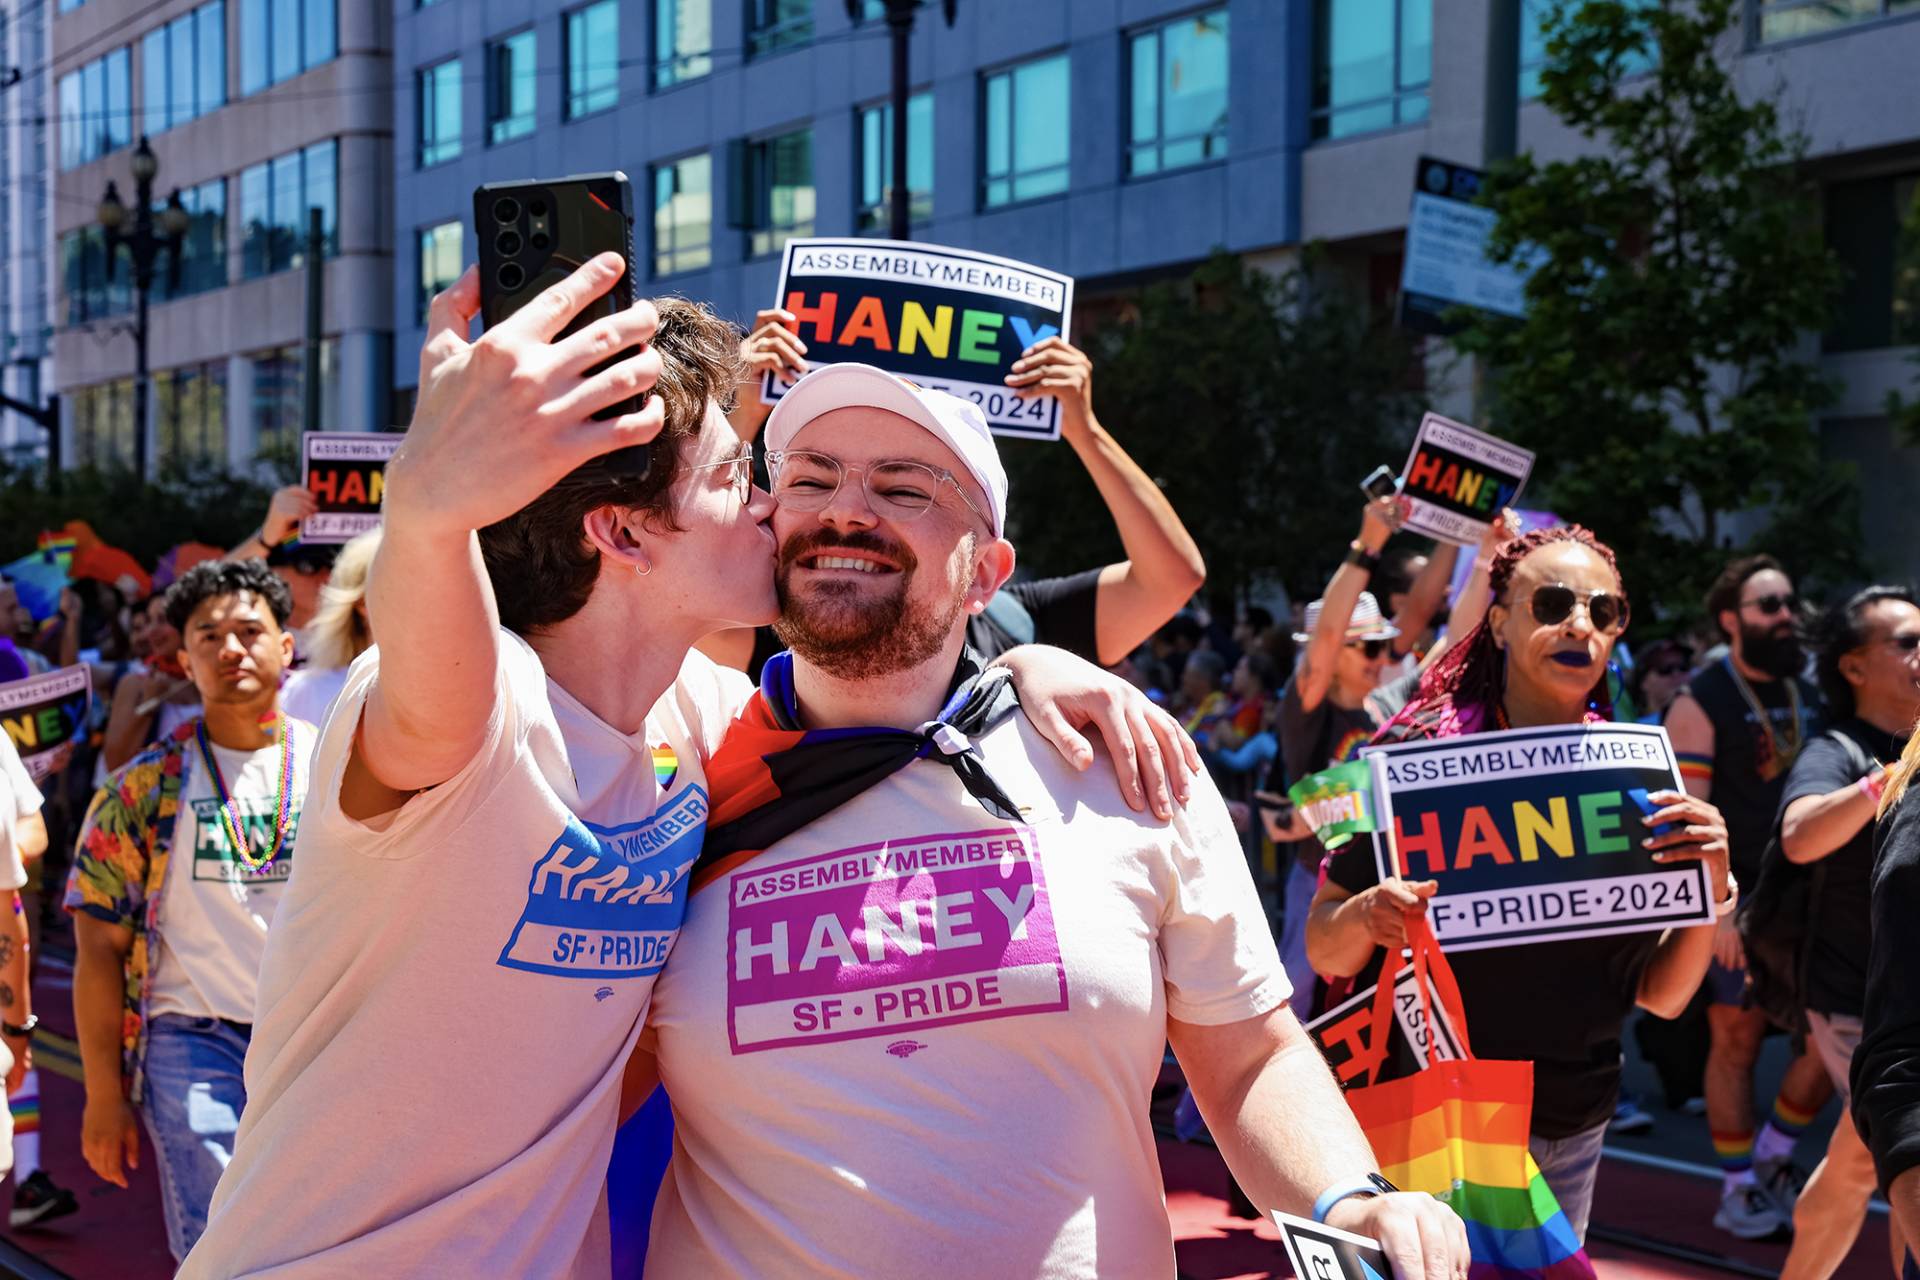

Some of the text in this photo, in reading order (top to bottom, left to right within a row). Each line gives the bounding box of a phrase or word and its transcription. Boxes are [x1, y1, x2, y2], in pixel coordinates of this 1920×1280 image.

[799, 254, 1055, 302] ASSEMBLYMEMBER
[784, 291, 1059, 365] HANEY
[1408, 451, 1515, 512] HANEY
[2, 698, 86, 749] NEY
[1387, 741, 1660, 783] ASSEMBLYMEMBER
[741, 839, 1026, 901] ASSEMBLYMEMBER
[735, 883, 1035, 981] HANEY
[875, 976, 1002, 1022] PRIDE
